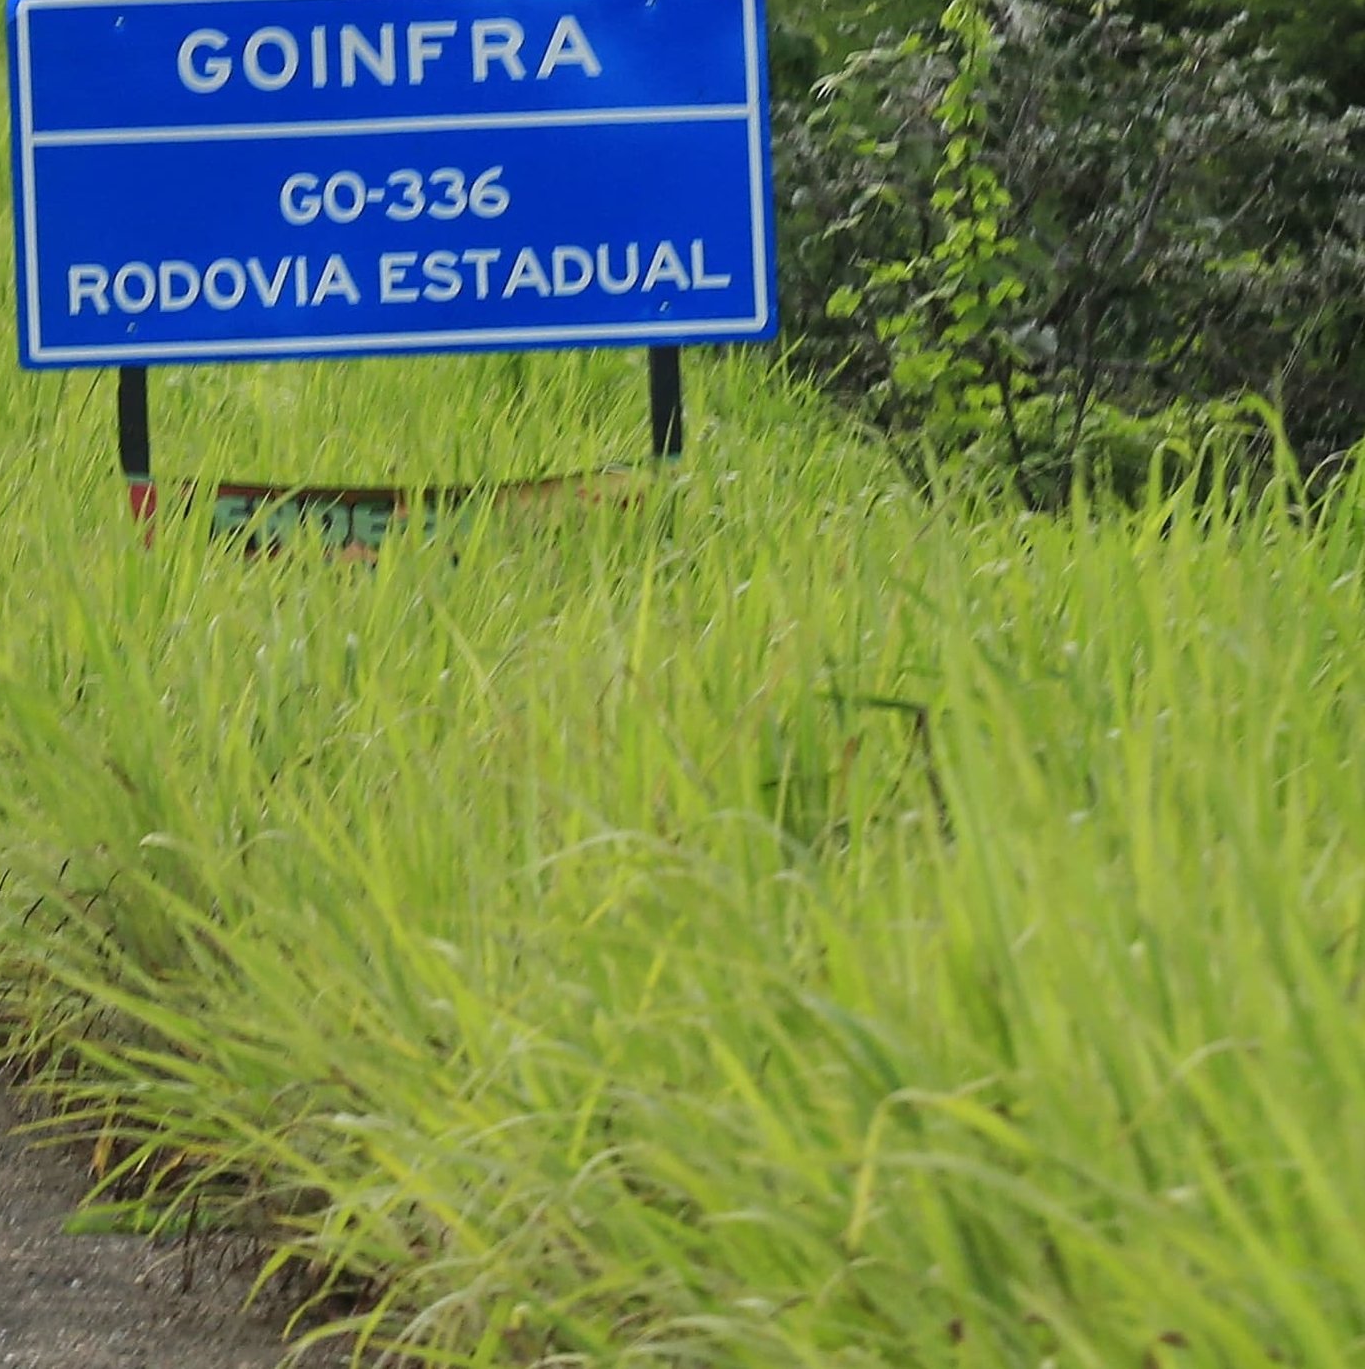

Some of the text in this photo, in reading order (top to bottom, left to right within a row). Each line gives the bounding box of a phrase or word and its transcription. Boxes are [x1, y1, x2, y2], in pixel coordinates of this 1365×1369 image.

[176, 15, 601, 93] GOINFRA
[279, 166, 510, 224] GO-336
[67, 239, 731, 314] RODOVIA ESTADUAL
